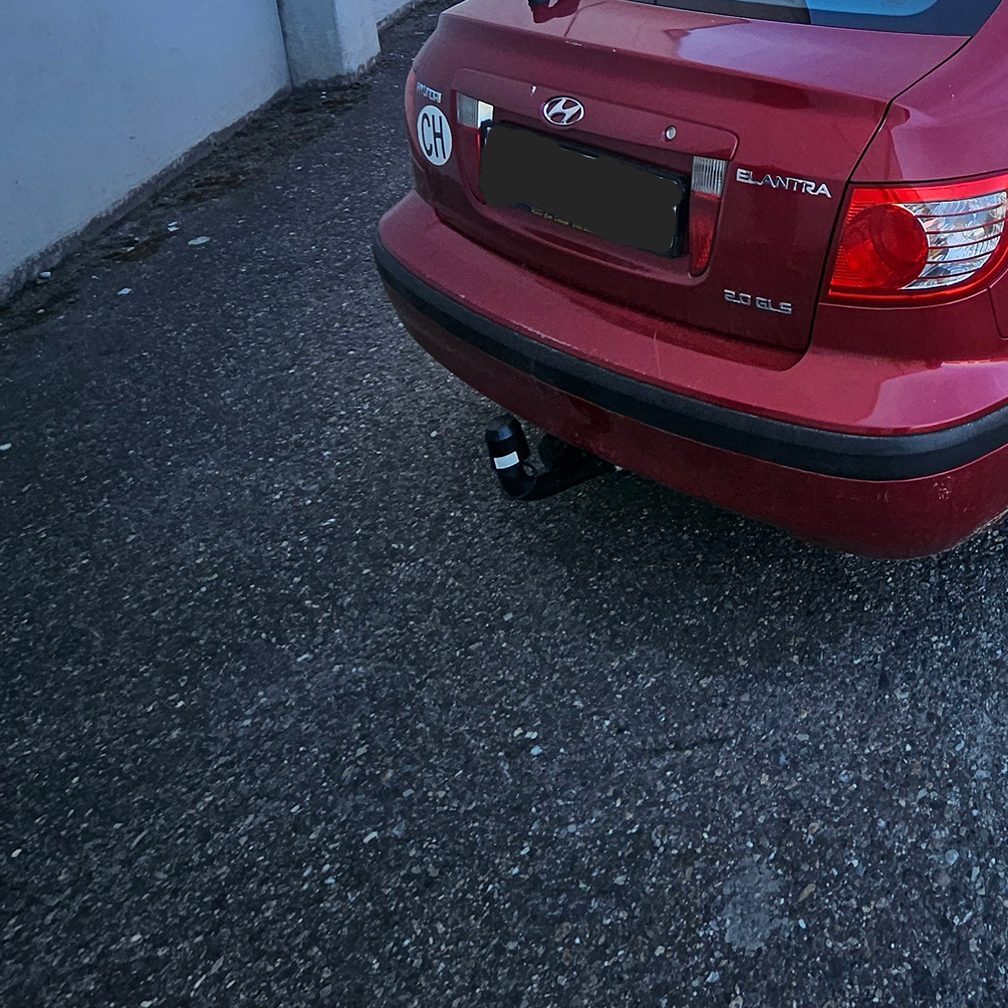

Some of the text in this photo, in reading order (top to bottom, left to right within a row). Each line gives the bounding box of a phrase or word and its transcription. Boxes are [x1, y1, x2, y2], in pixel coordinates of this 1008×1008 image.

[421, 112, 446, 160] CH
[736, 168, 832, 199] ELANTRA
[755, 296, 792, 315] GLS
